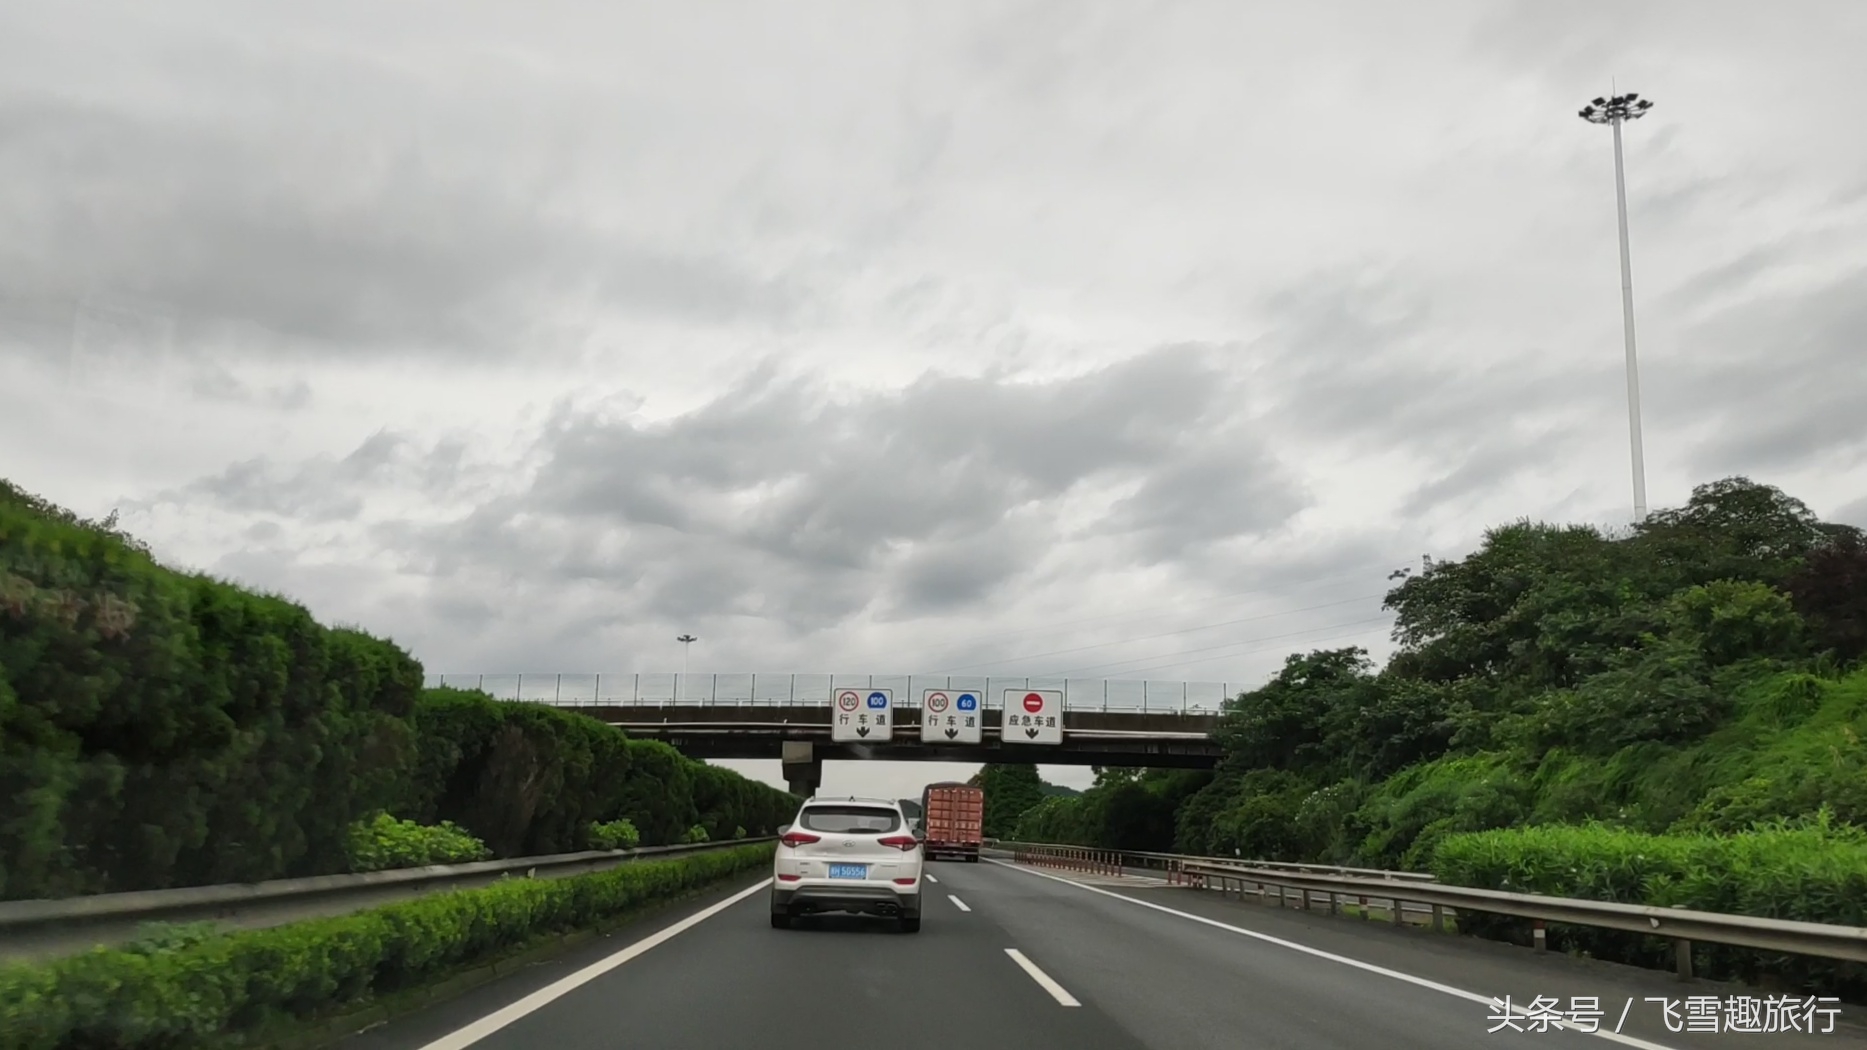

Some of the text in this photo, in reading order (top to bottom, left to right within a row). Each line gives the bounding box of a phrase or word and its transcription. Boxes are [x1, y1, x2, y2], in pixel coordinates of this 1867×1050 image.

[843, 697, 856, 706] 120
[870, 696, 884, 706] 100
[932, 698, 945, 707] 100
[961, 699, 972, 708] 60
[839, 713, 886, 726] 行车道
[928, 714, 975, 728] 行车道
[1008, 714, 1056, 728] 应急车道
